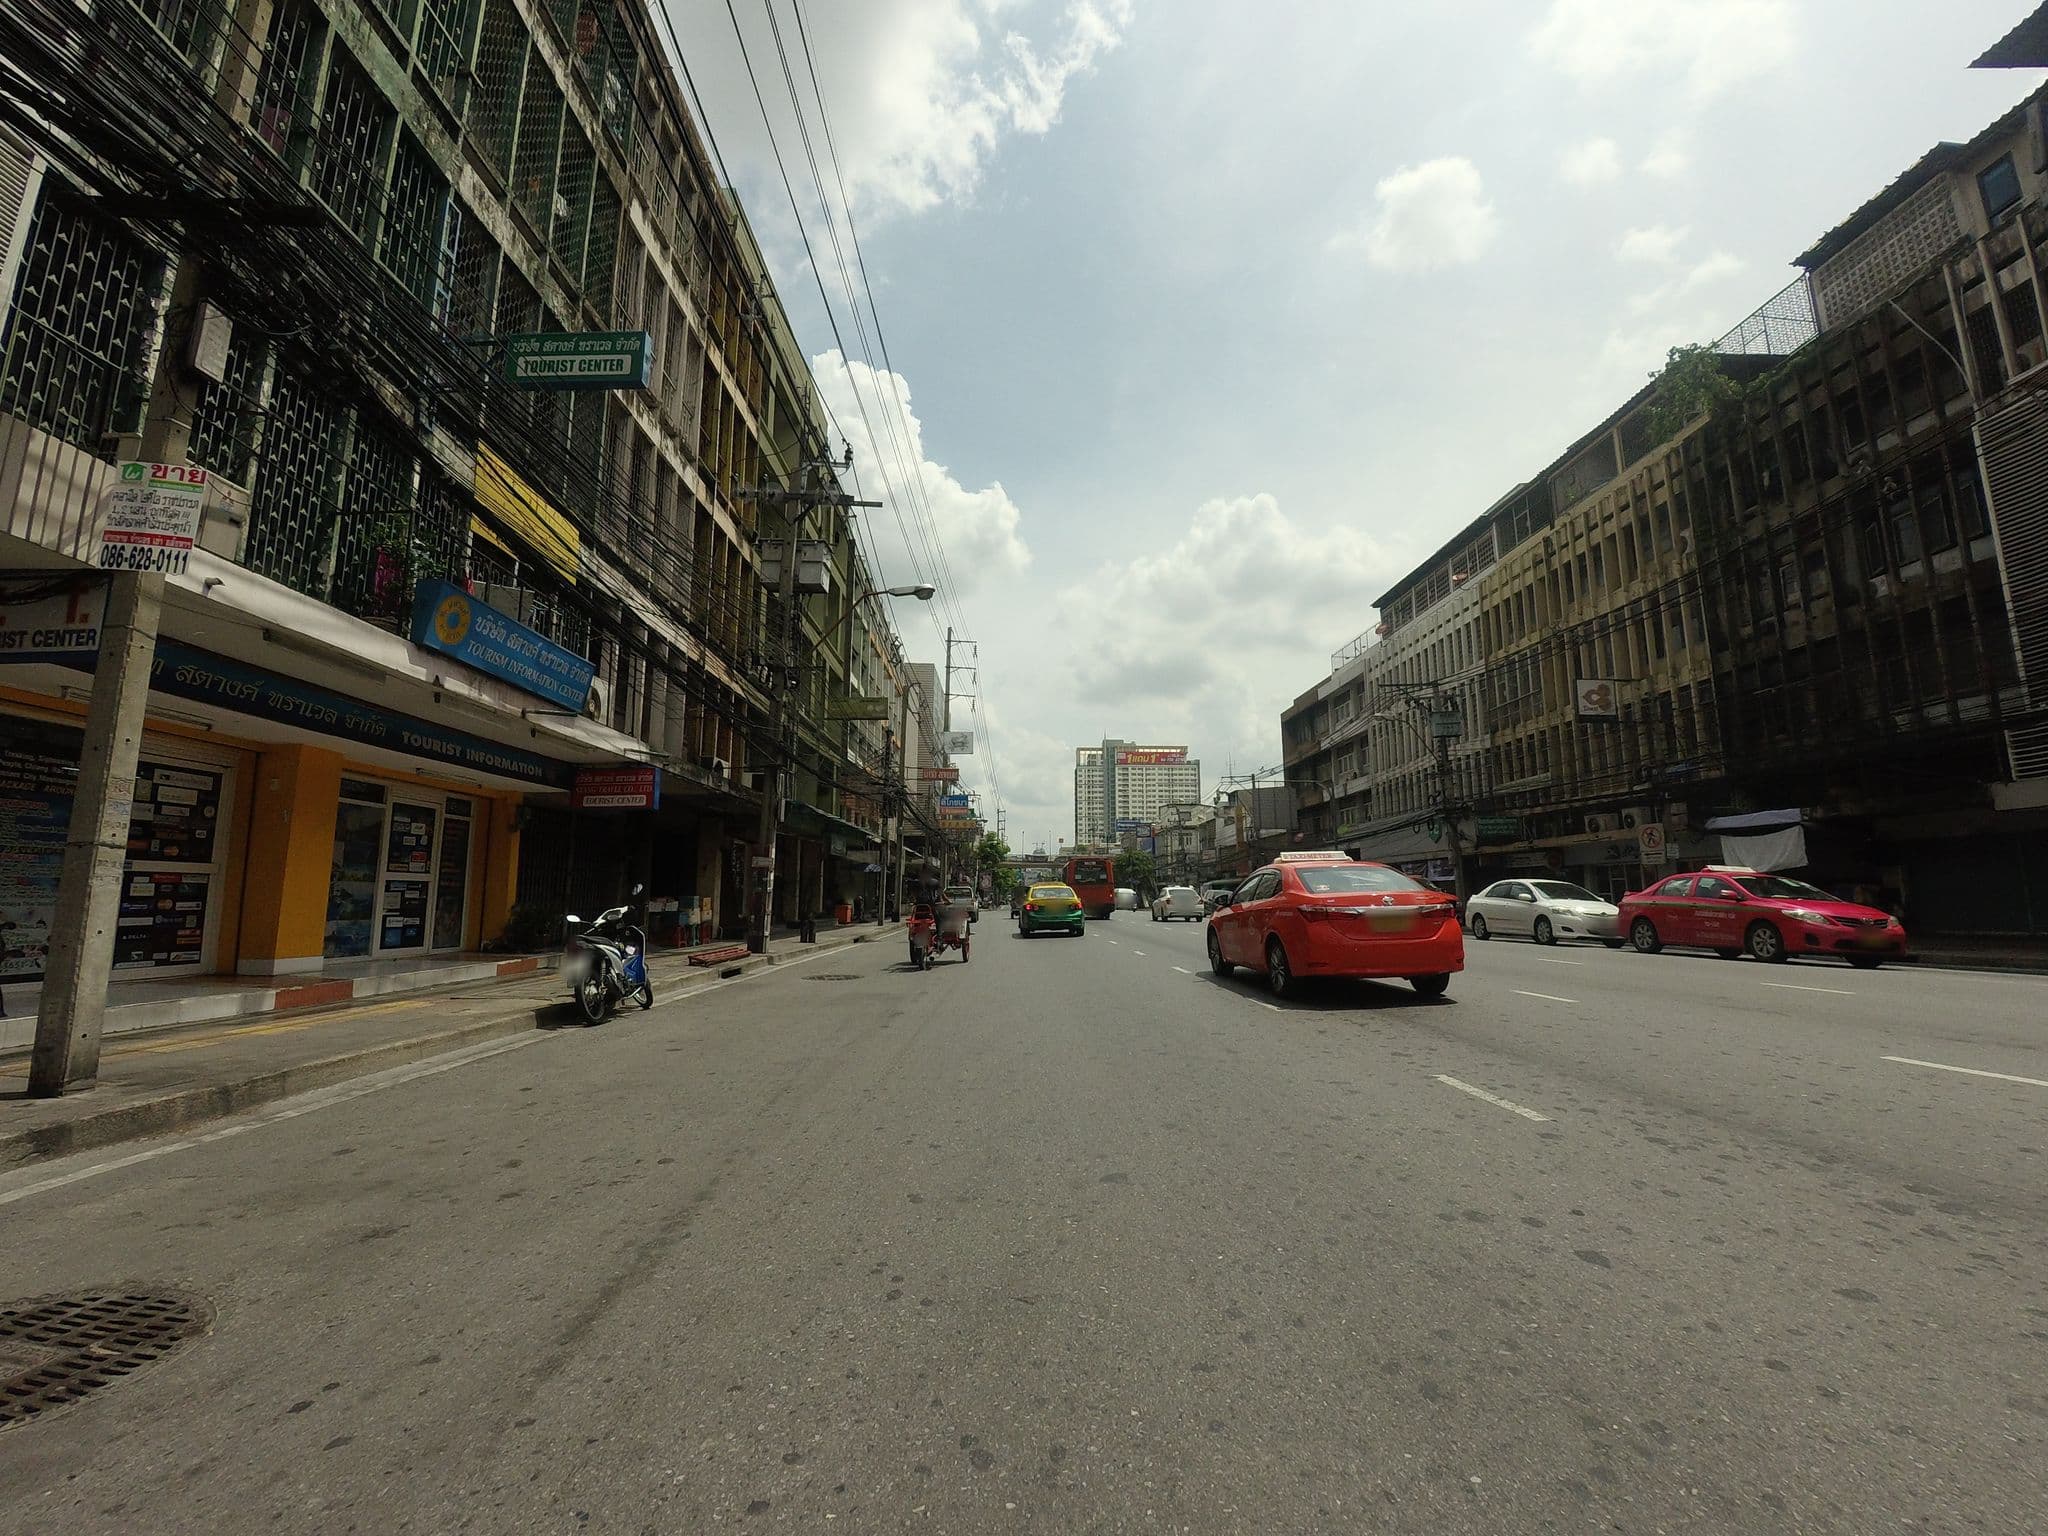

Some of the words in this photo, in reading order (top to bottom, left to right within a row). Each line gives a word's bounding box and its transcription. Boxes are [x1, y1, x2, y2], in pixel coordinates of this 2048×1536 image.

[523, 359, 577, 373] TOURIST
[579, 359, 624, 372] CENTER
[150, 463, 207, 485] ขาย
[100, 544, 189, 575] 086-628-0111
[31, 629, 97, 648] CENTER
[466, 638, 509, 668] TOURISM
[507, 657, 559, 693] INFORMATION
[558, 683, 585, 703] CENTER
[402, 730, 463, 758] TOURIST
[465, 748, 543, 777] INFORMATION
